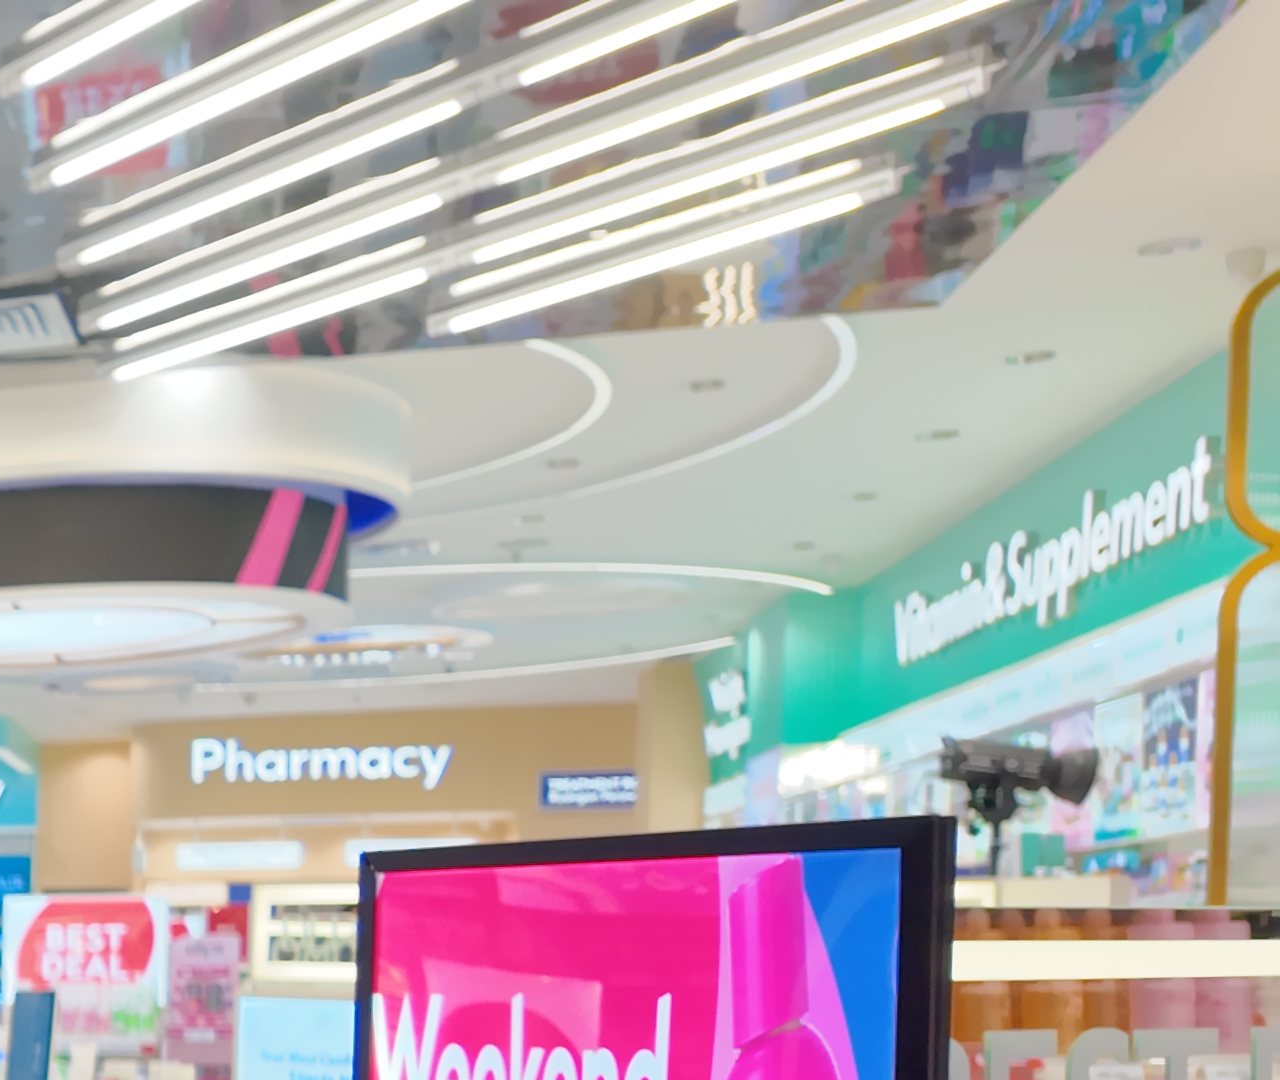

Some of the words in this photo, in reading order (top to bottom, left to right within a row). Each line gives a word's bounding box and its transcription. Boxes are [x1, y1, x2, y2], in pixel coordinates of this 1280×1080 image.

[190, 737, 453, 791] Pharmacy
[45, 922, 128, 953] BEST
[41, 952, 130, 985] DEAL
